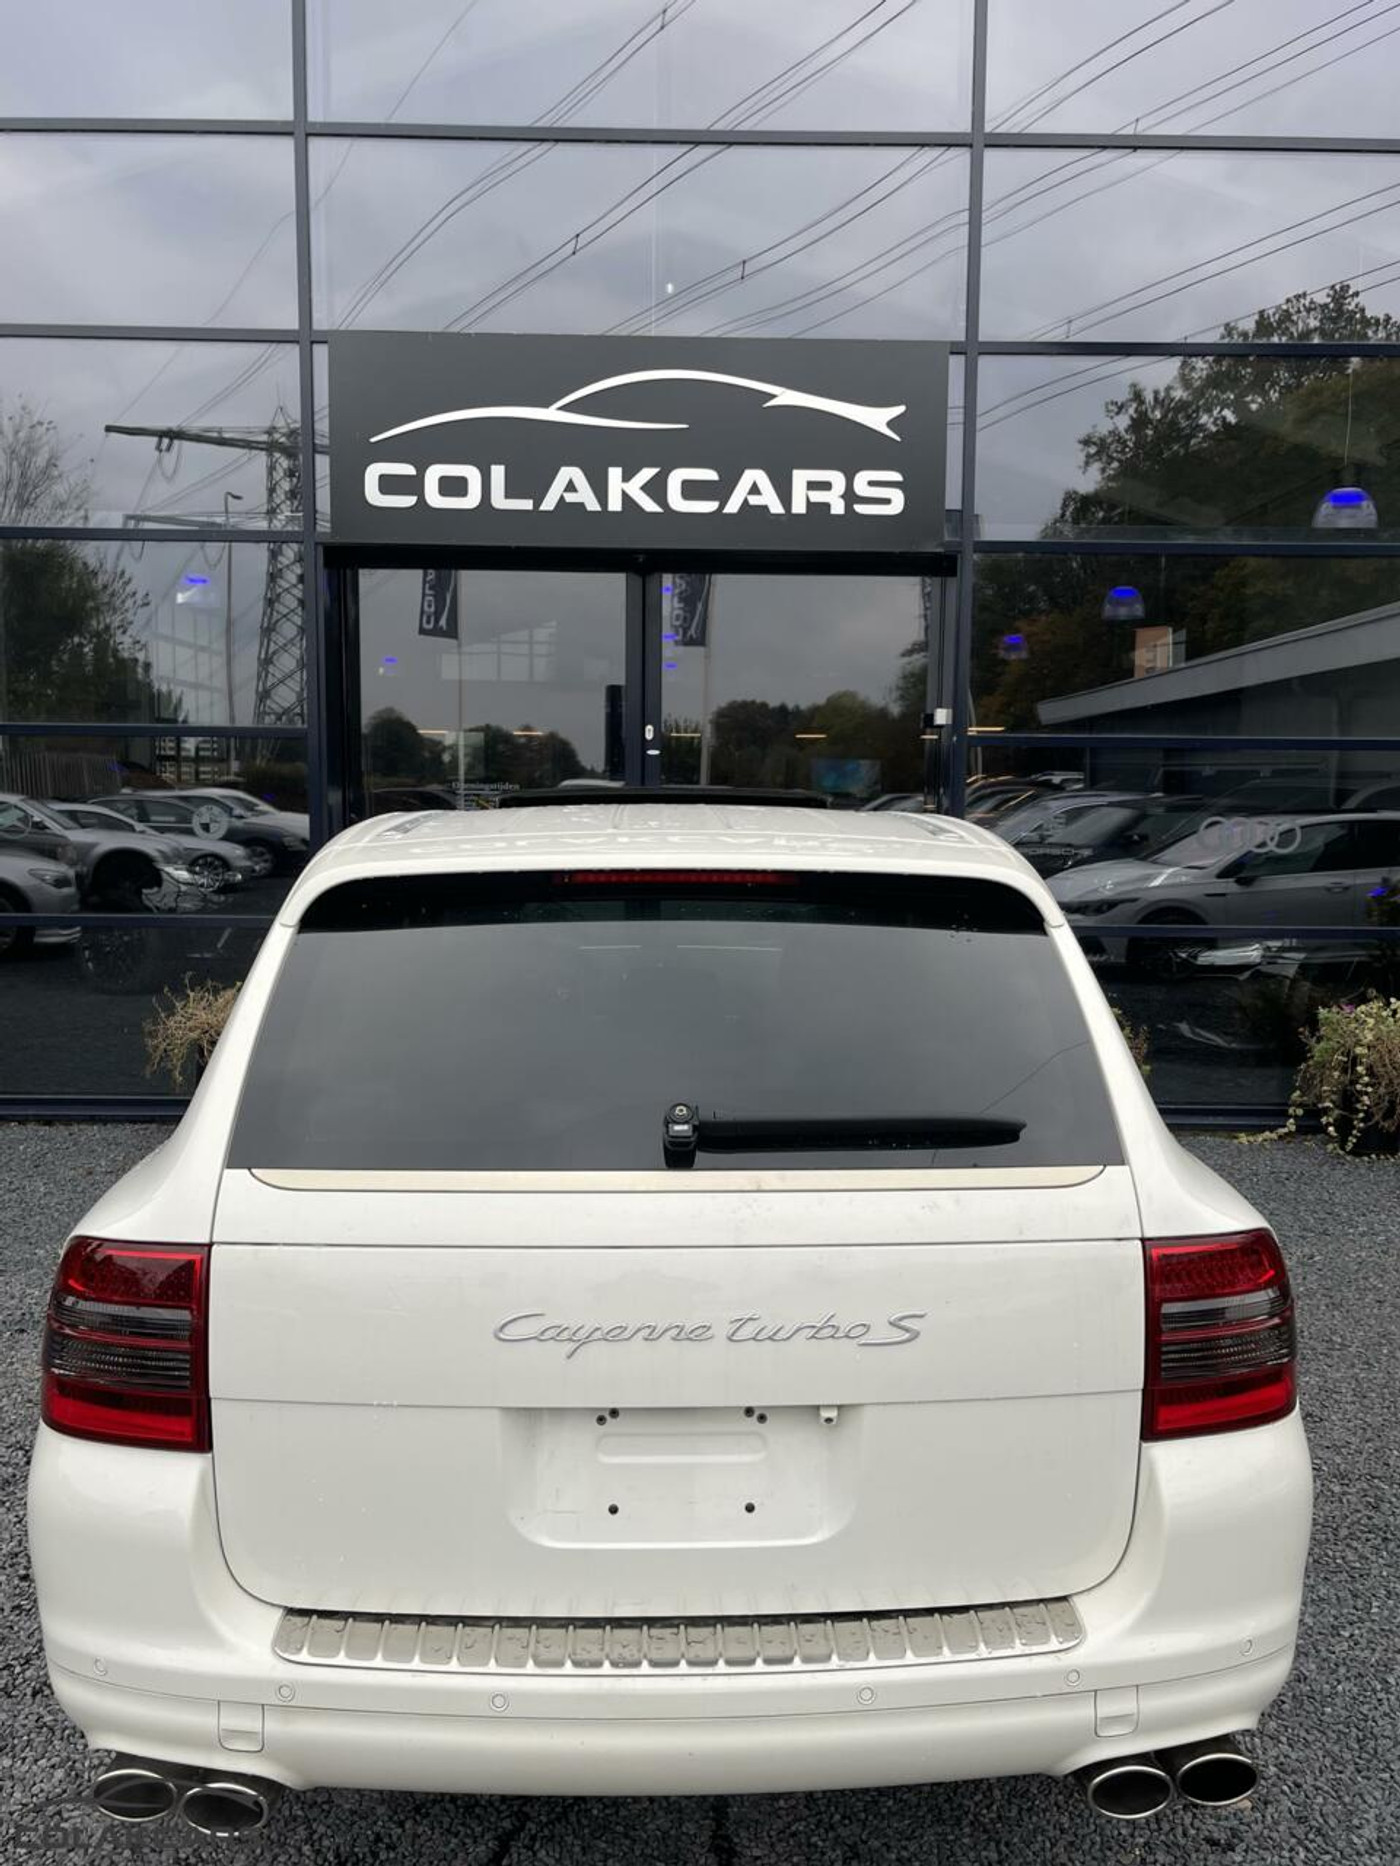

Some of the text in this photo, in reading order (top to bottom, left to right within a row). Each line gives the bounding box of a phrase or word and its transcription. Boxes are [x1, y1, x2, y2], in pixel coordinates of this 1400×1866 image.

[364, 461, 905, 516] COLAKCARS
[494, 1310, 927, 1358] Cayenne turbo S
